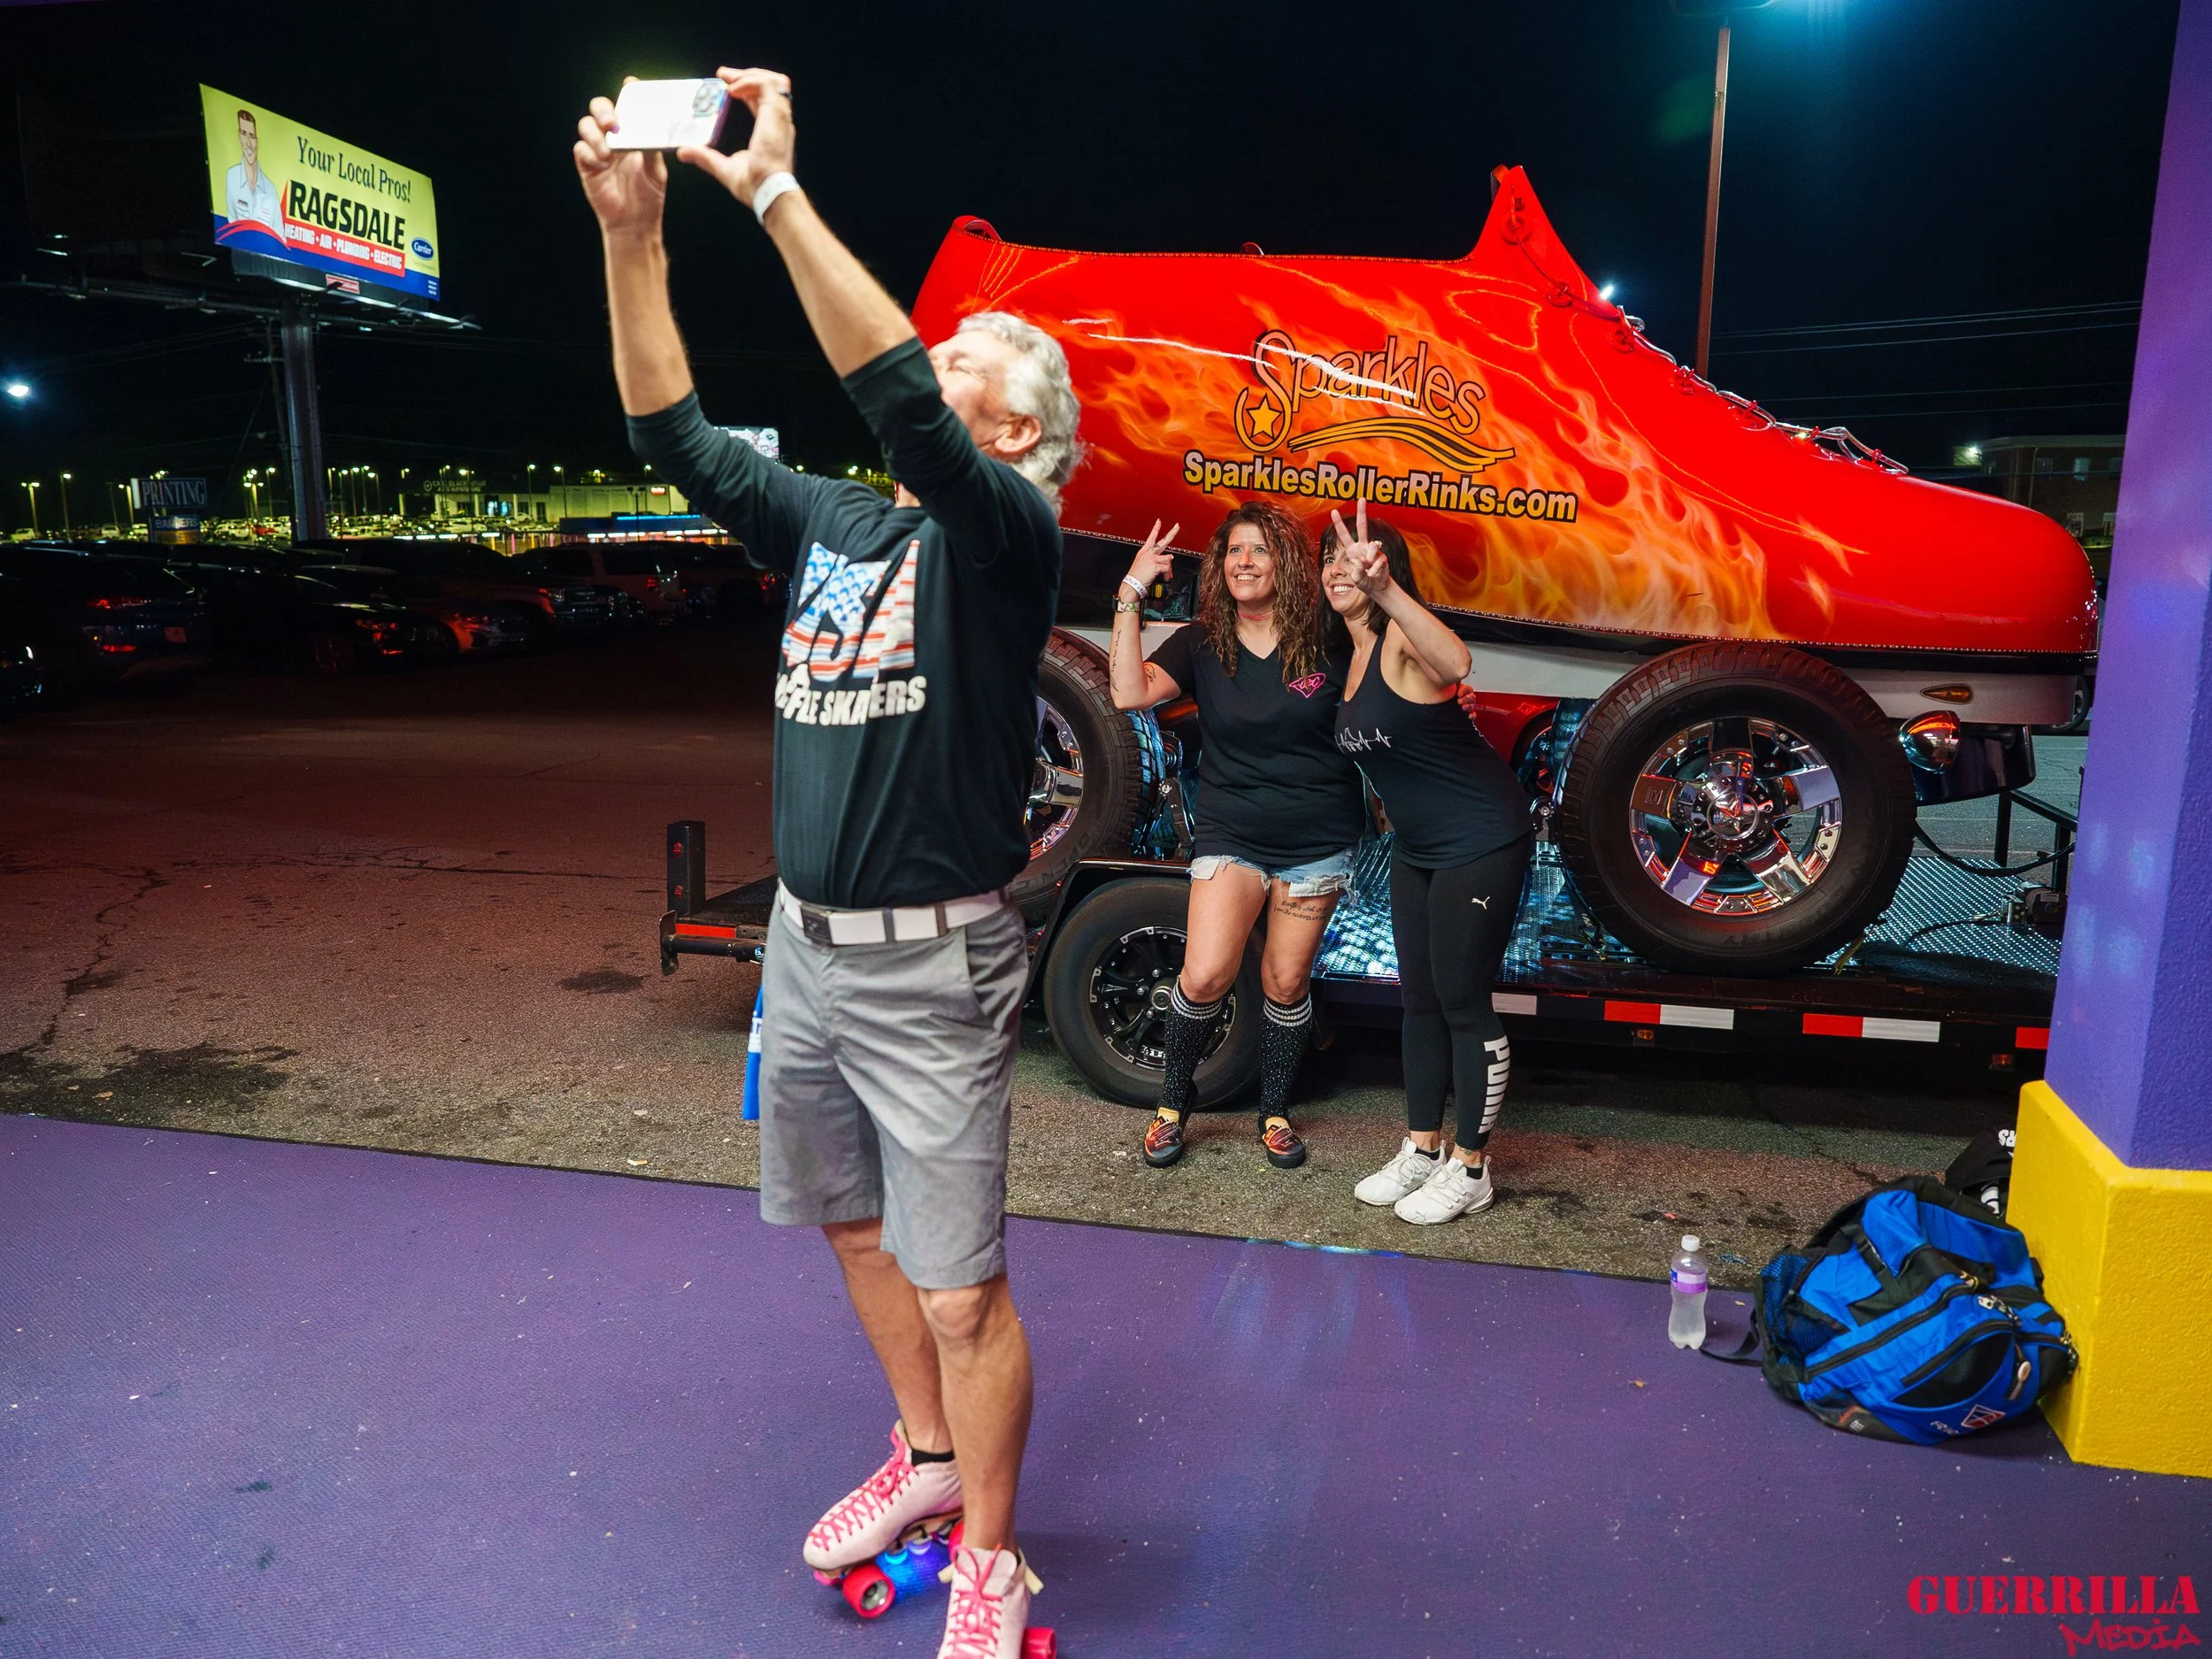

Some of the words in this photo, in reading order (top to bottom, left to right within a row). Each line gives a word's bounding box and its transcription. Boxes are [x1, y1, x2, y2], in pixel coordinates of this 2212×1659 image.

[297, 135, 334, 173] Your
[338, 152, 375, 189] Local
[379, 168, 411, 203] Pros!
[285, 222, 315, 245] HEATING
[319, 234, 333, 250] AIR
[336, 237, 370, 260] PLUMBING
[373, 249, 403, 269] ELECTRIC
[288, 180, 406, 250] RAGSDALE
[413, 242, 433, 255] Carrier
[1234, 329, 1486, 453] Sparkles
[142, 480, 205, 506] PRINTING
[1183, 449, 1578, 522] SparklesRollerRinks.com
